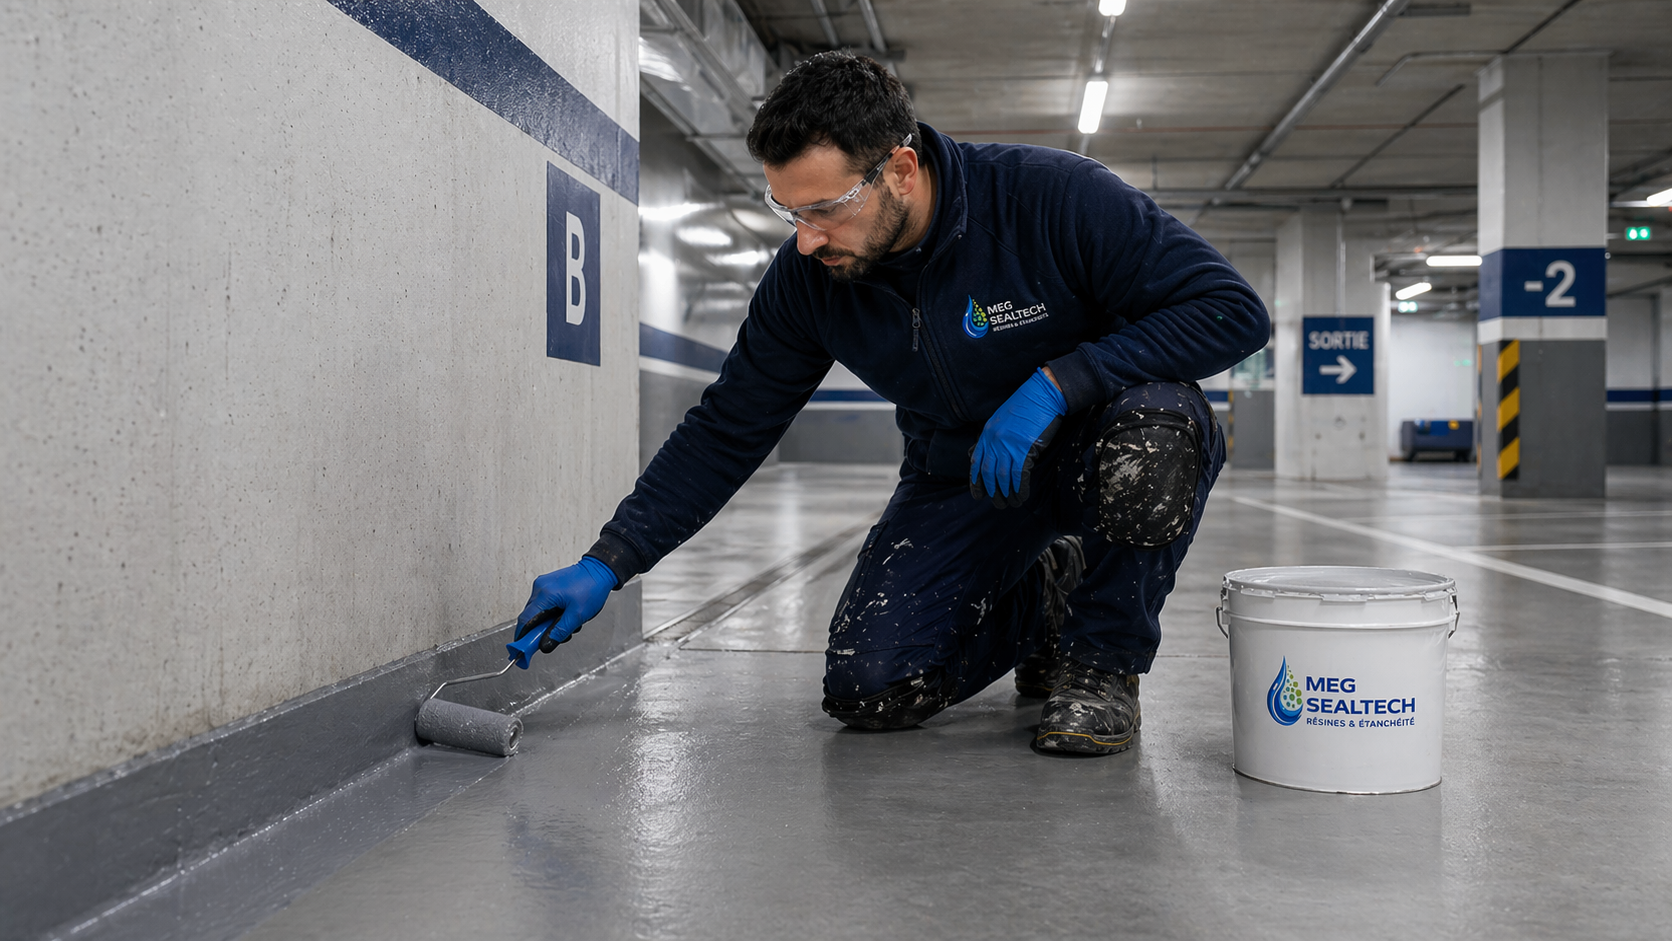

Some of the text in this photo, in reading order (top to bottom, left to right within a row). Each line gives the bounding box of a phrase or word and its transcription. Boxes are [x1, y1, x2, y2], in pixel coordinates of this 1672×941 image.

[566, 211, 587, 326] B
[1524, 260, 1577, 308] -2
[987, 301, 1013, 315] MEG
[990, 303, 1047, 325] SEALTECH
[1308, 330, 1370, 350] SORTIE
[1306, 676, 1356, 693] MEG
[1306, 697, 1416, 715] SEALTECH
[1306, 717, 1346, 727] RÉSINES
[1359, 717, 1415, 728] ÉTANCHÉITÉ
